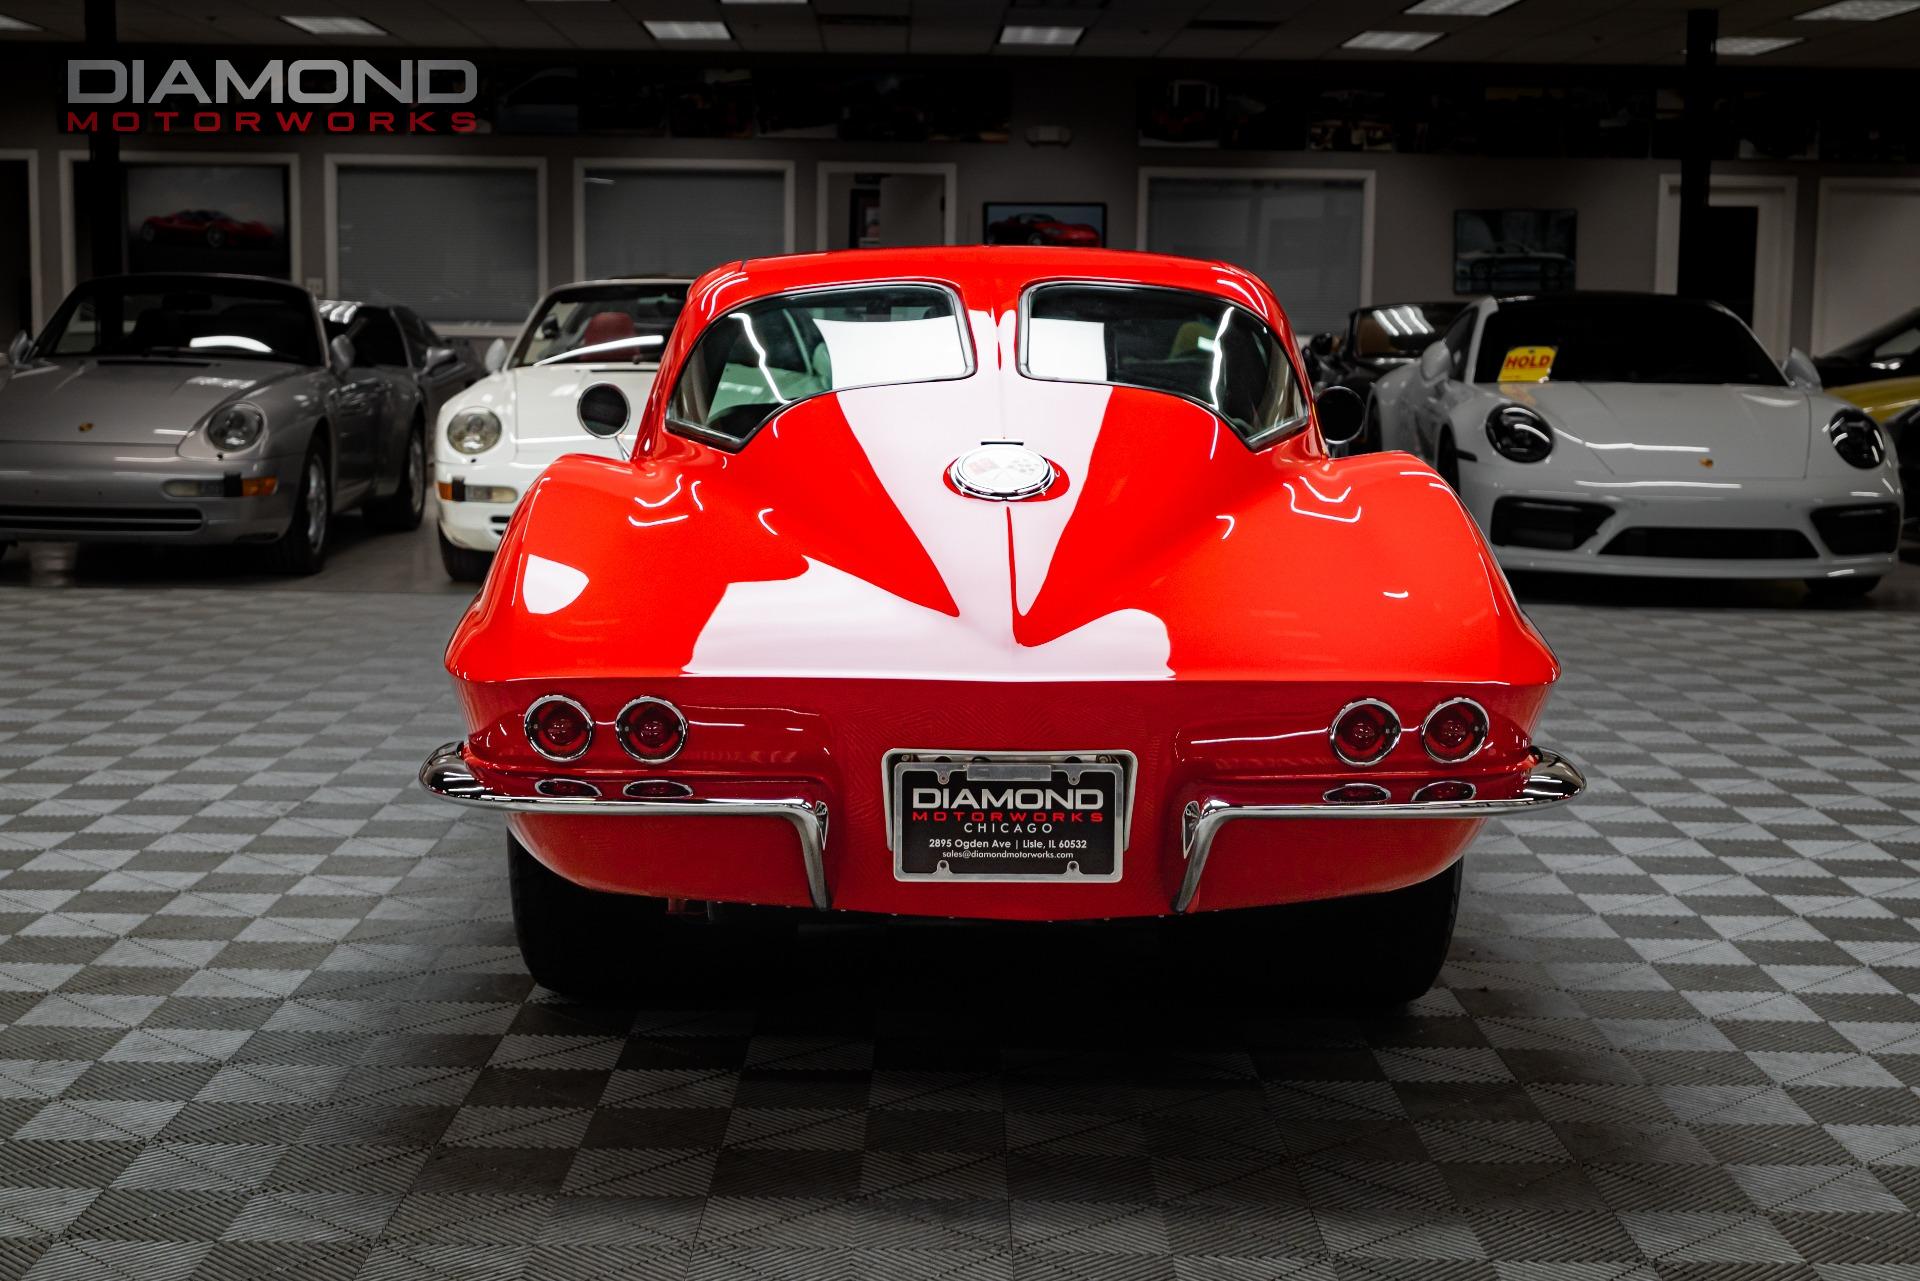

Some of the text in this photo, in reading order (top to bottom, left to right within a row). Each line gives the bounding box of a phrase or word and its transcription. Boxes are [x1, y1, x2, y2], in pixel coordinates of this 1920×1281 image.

[1504, 355, 1551, 368] HOLD
[912, 788, 1104, 810] DIAMOND
[912, 811, 1104, 822] MOTORWORKS
[963, 822, 1053, 834] CHICAGO
[929, 839, 952, 848] 2895
[954, 839, 989, 850] Ogden
[991, 839, 1012, 848] Ave
[1022, 839, 1046, 850] Lisle,
[1048, 839, 1057, 849] IL
[1058, 839, 1087, 849] 60532
[942, 849, 1074, 859] sales@diamondmotorworks.com
